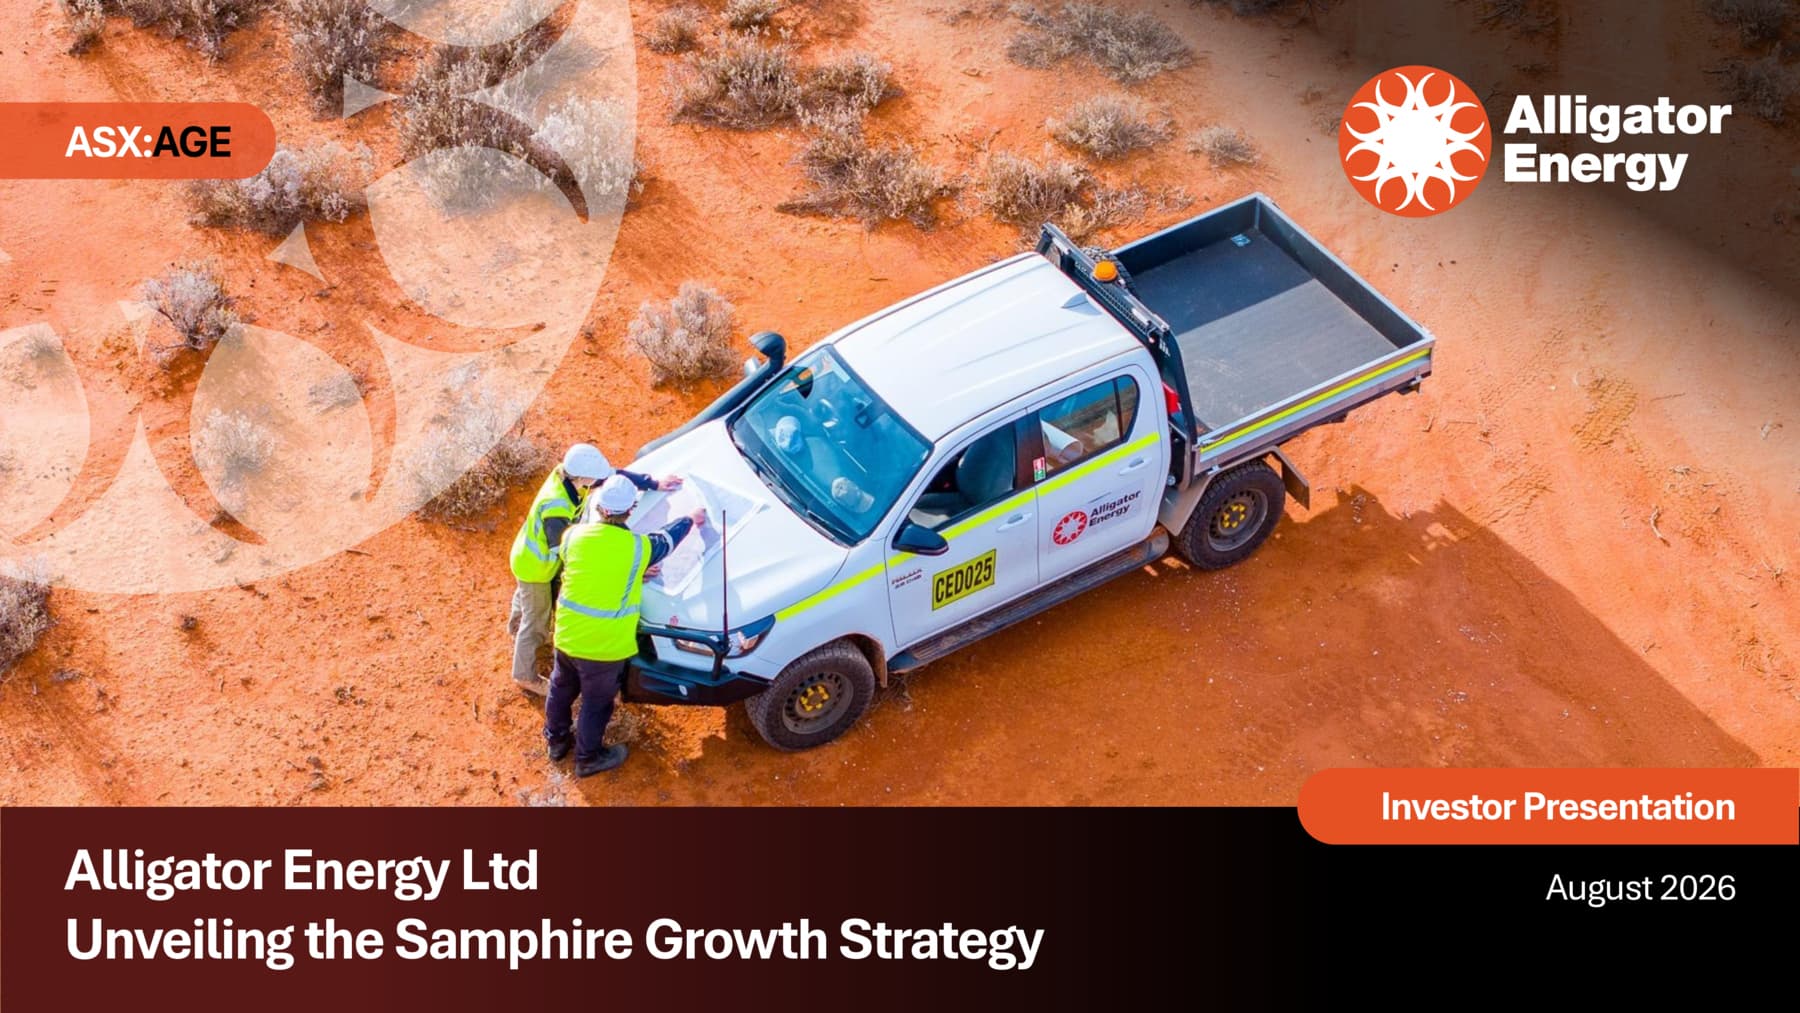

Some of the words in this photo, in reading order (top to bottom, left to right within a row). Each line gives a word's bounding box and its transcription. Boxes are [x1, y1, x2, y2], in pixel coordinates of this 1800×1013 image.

[1089, 504, 1130, 527] Energy
[1090, 490, 1141, 517] Alligator
[935, 556, 993, 603] CED025
